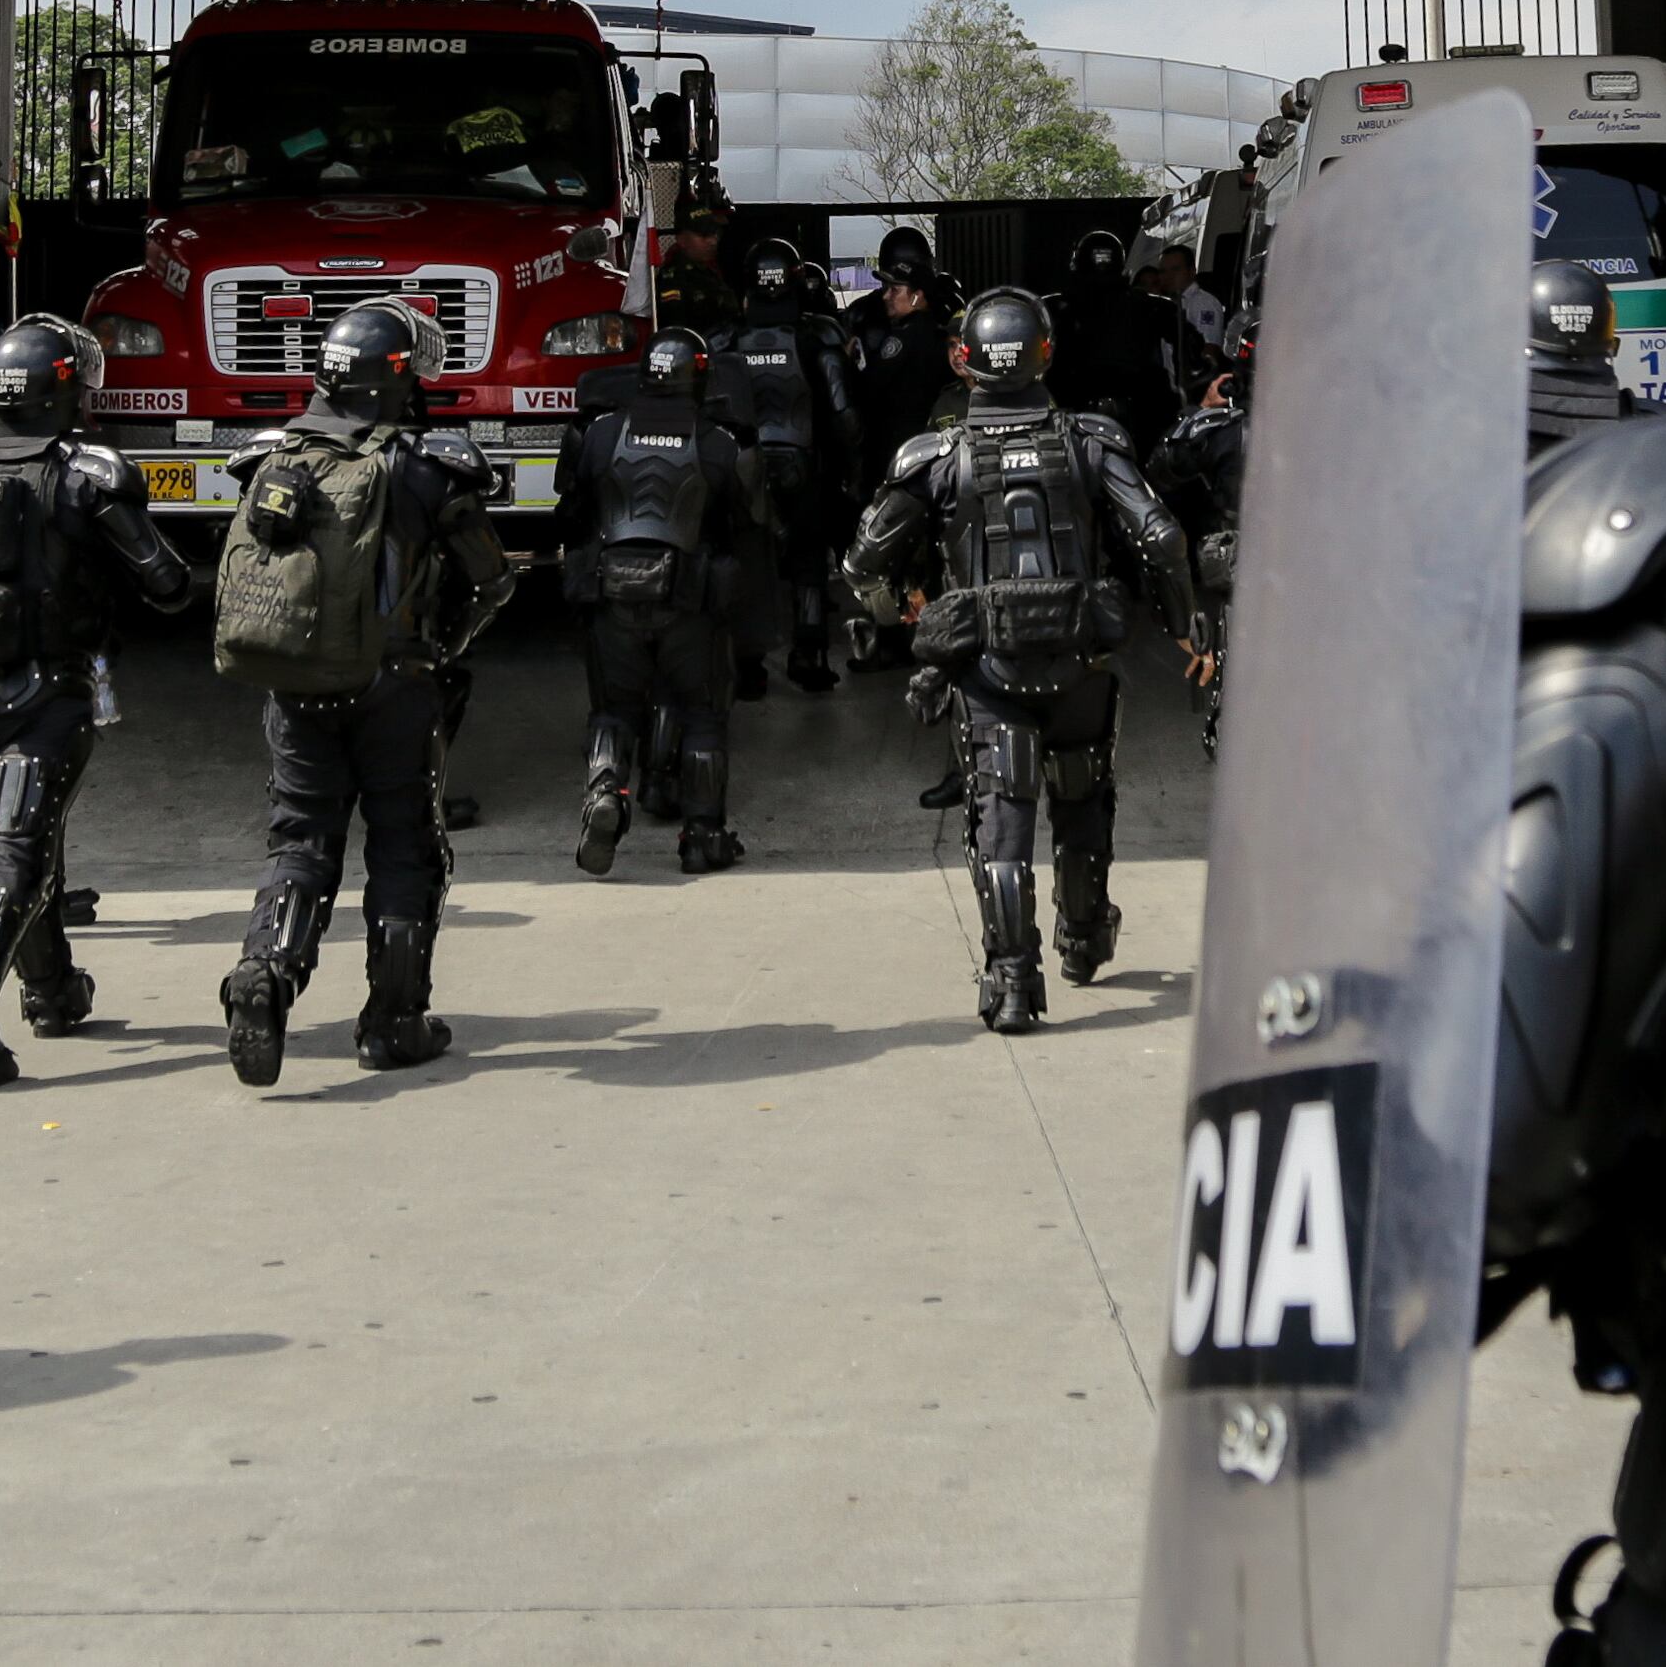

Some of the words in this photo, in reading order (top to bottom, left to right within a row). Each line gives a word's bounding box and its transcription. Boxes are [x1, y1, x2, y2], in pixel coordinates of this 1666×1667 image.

[1568, 109, 1610, 121] Calidad
[1623, 109, 1662, 121] Servicio
[166, 260, 190, 292] 123
[533, 250, 564, 283] 123
[91, 392, 183, 411] BOMBEROS
[1172, 1100, 1356, 1357] CIA
